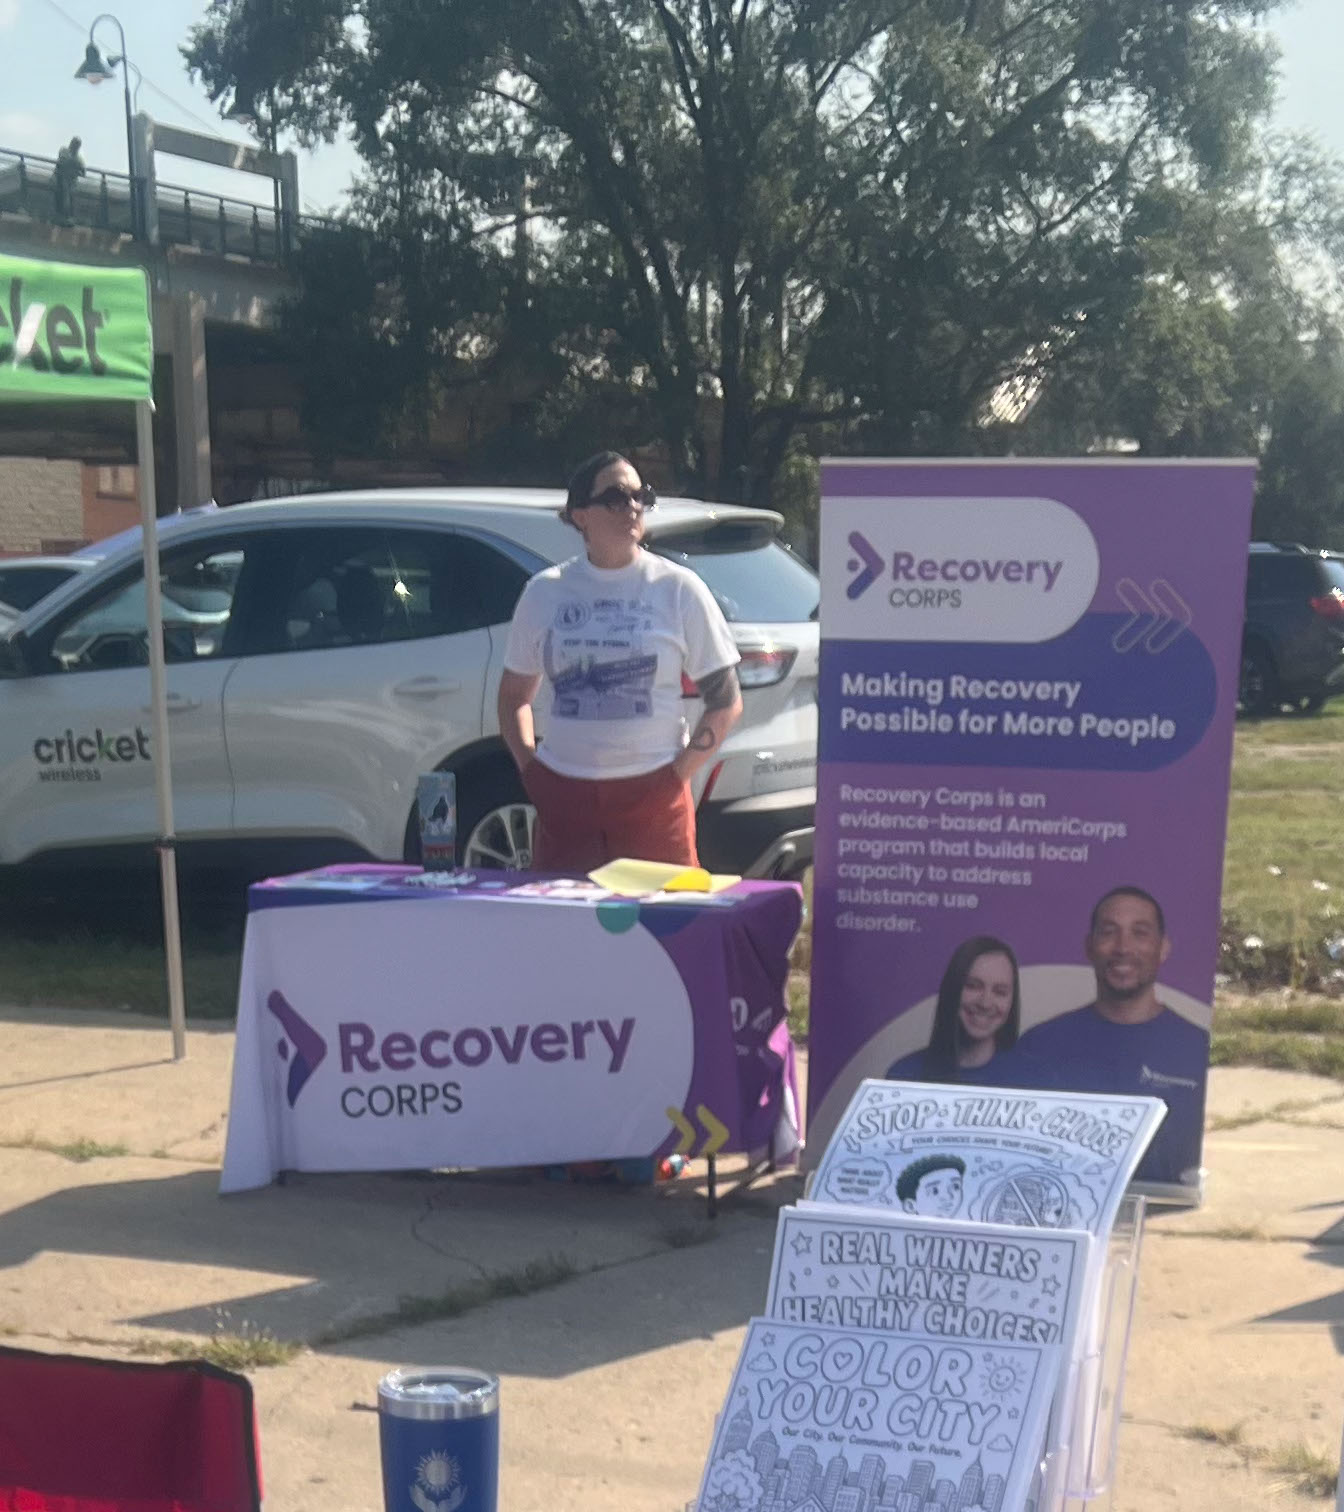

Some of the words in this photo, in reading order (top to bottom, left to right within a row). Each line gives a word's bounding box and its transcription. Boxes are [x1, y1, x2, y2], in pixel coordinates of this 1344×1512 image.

[891, 550, 1063, 593] Recovery
[888, 587, 962, 609] CORPS
[841, 673, 944, 705] Making
[949, 675, 1082, 708] Recovery
[34, 725, 153, 764] cricket
[841, 707, 955, 735] Possible
[957, 709, 998, 735] for
[1002, 711, 1075, 738] More
[1079, 714, 1177, 747] People
[38, 767, 102, 782] wireless
[840, 783, 931, 810] Recovery
[935, 786, 993, 813] Corps
[997, 787, 1015, 807] is
[1018, 791, 1046, 808] an
[838, 810, 1003, 835] evidence-based
[1006, 814, 1128, 842] AmeriCorps
[837, 840, 924, 861] program
[929, 838, 970, 860] that
[974, 838, 1036, 862] builds
[1039, 840, 1089, 863] local
[836, 862, 924, 889] capacity
[927, 865, 947, 886] to
[951, 865, 1033, 887] address
[836, 886, 939, 908] substance
[943, 893, 979, 910] use
[835, 911, 922, 935] disorder.
[337, 1017, 636, 1075] Recovery
[340, 1082, 463, 1119] CORPS
[856, 1099, 939, 1141] STOP
[952, 1097, 1035, 1129] THINK
[1039, 1105, 1133, 1158] CHOOSE
[820, 1230, 896, 1266] REAL
[904, 1233, 1042, 1283] WINNERS
[878, 1267, 970, 1304] MAKE
[781, 1296, 918, 1331] HEALTHY
[783, 1333, 973, 1397] COLOR
[756, 1377, 879, 1432] YOUR
[886, 1393, 1001, 1446] CITY
[781, 1425, 799, 1437] Our
[827, 1432, 845, 1443] Our
[907, 1441, 926, 1453] Our
